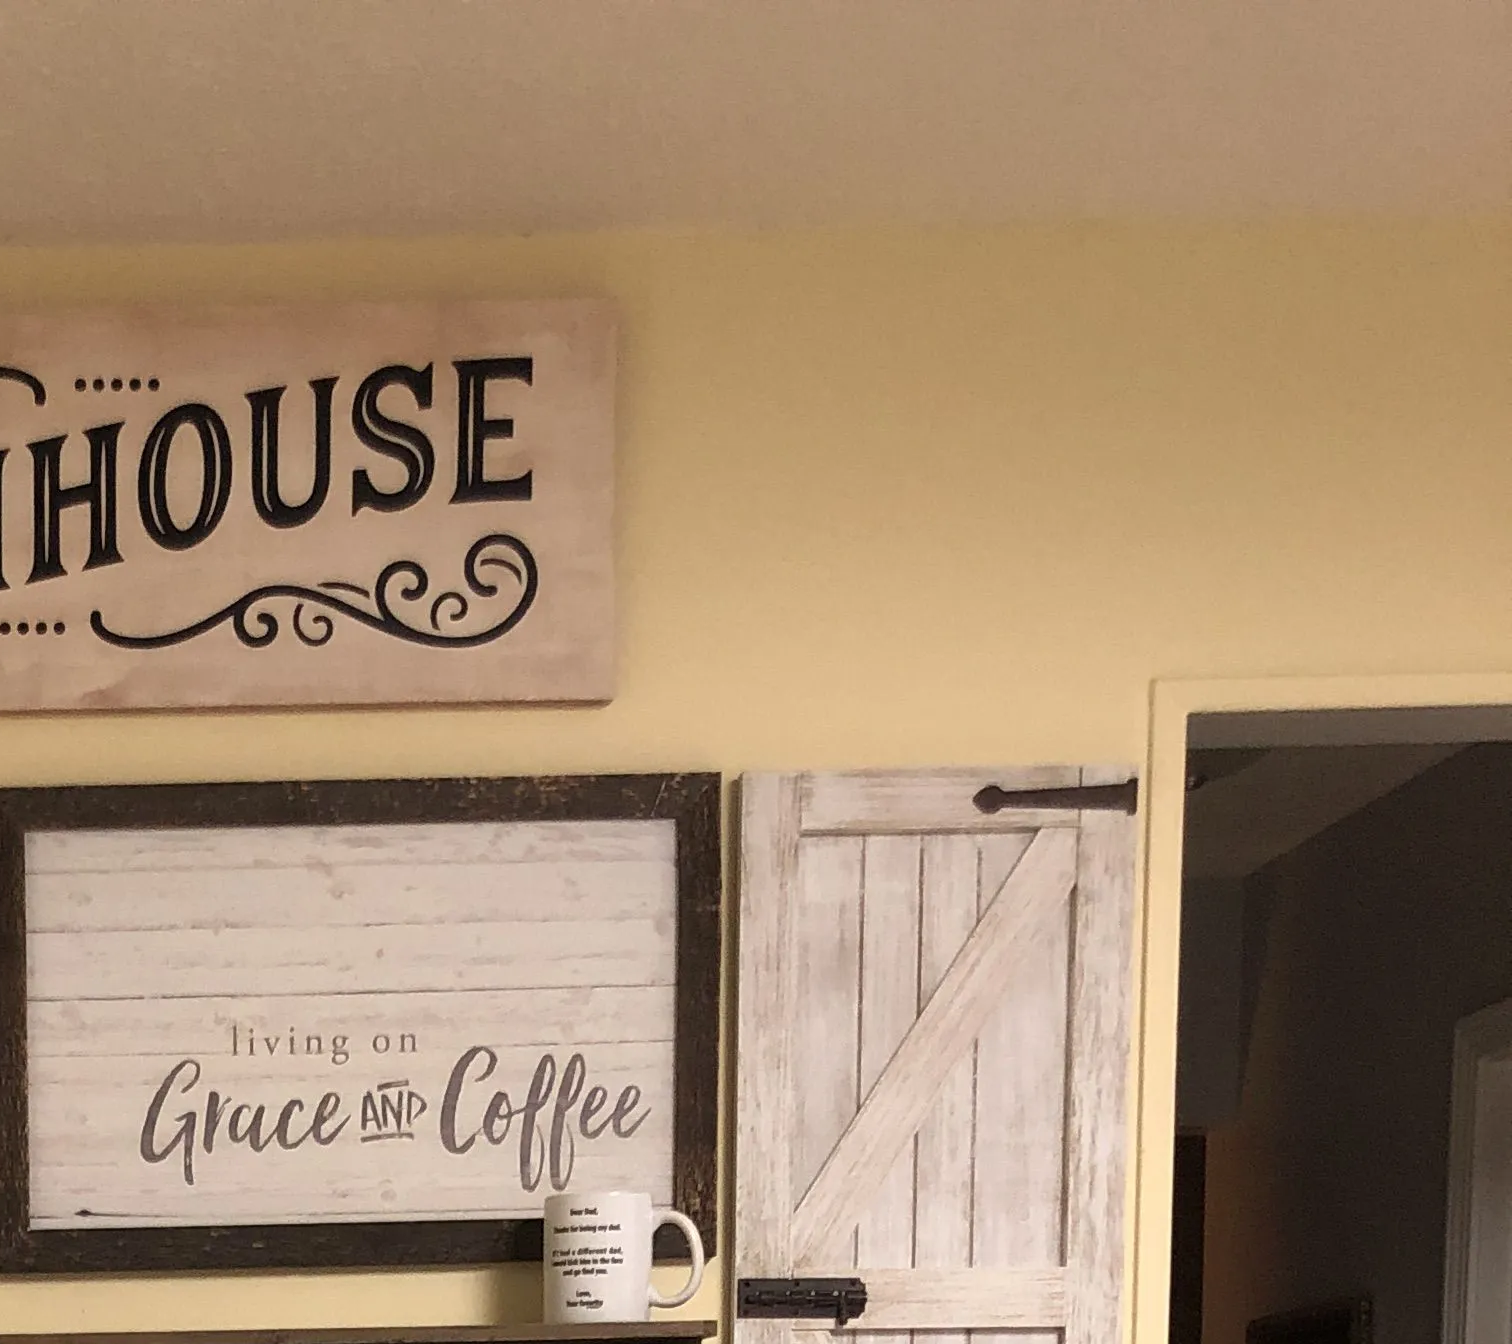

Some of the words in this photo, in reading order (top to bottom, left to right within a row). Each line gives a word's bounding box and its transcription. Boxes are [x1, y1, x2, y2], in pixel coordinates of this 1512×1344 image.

[231, 1025, 351, 1066] living
[371, 1031, 419, 1055] on
[139, 1058, 352, 1187] Grace
[360, 1085, 427, 1135] AND
[439, 1045, 652, 1193] Coffee
